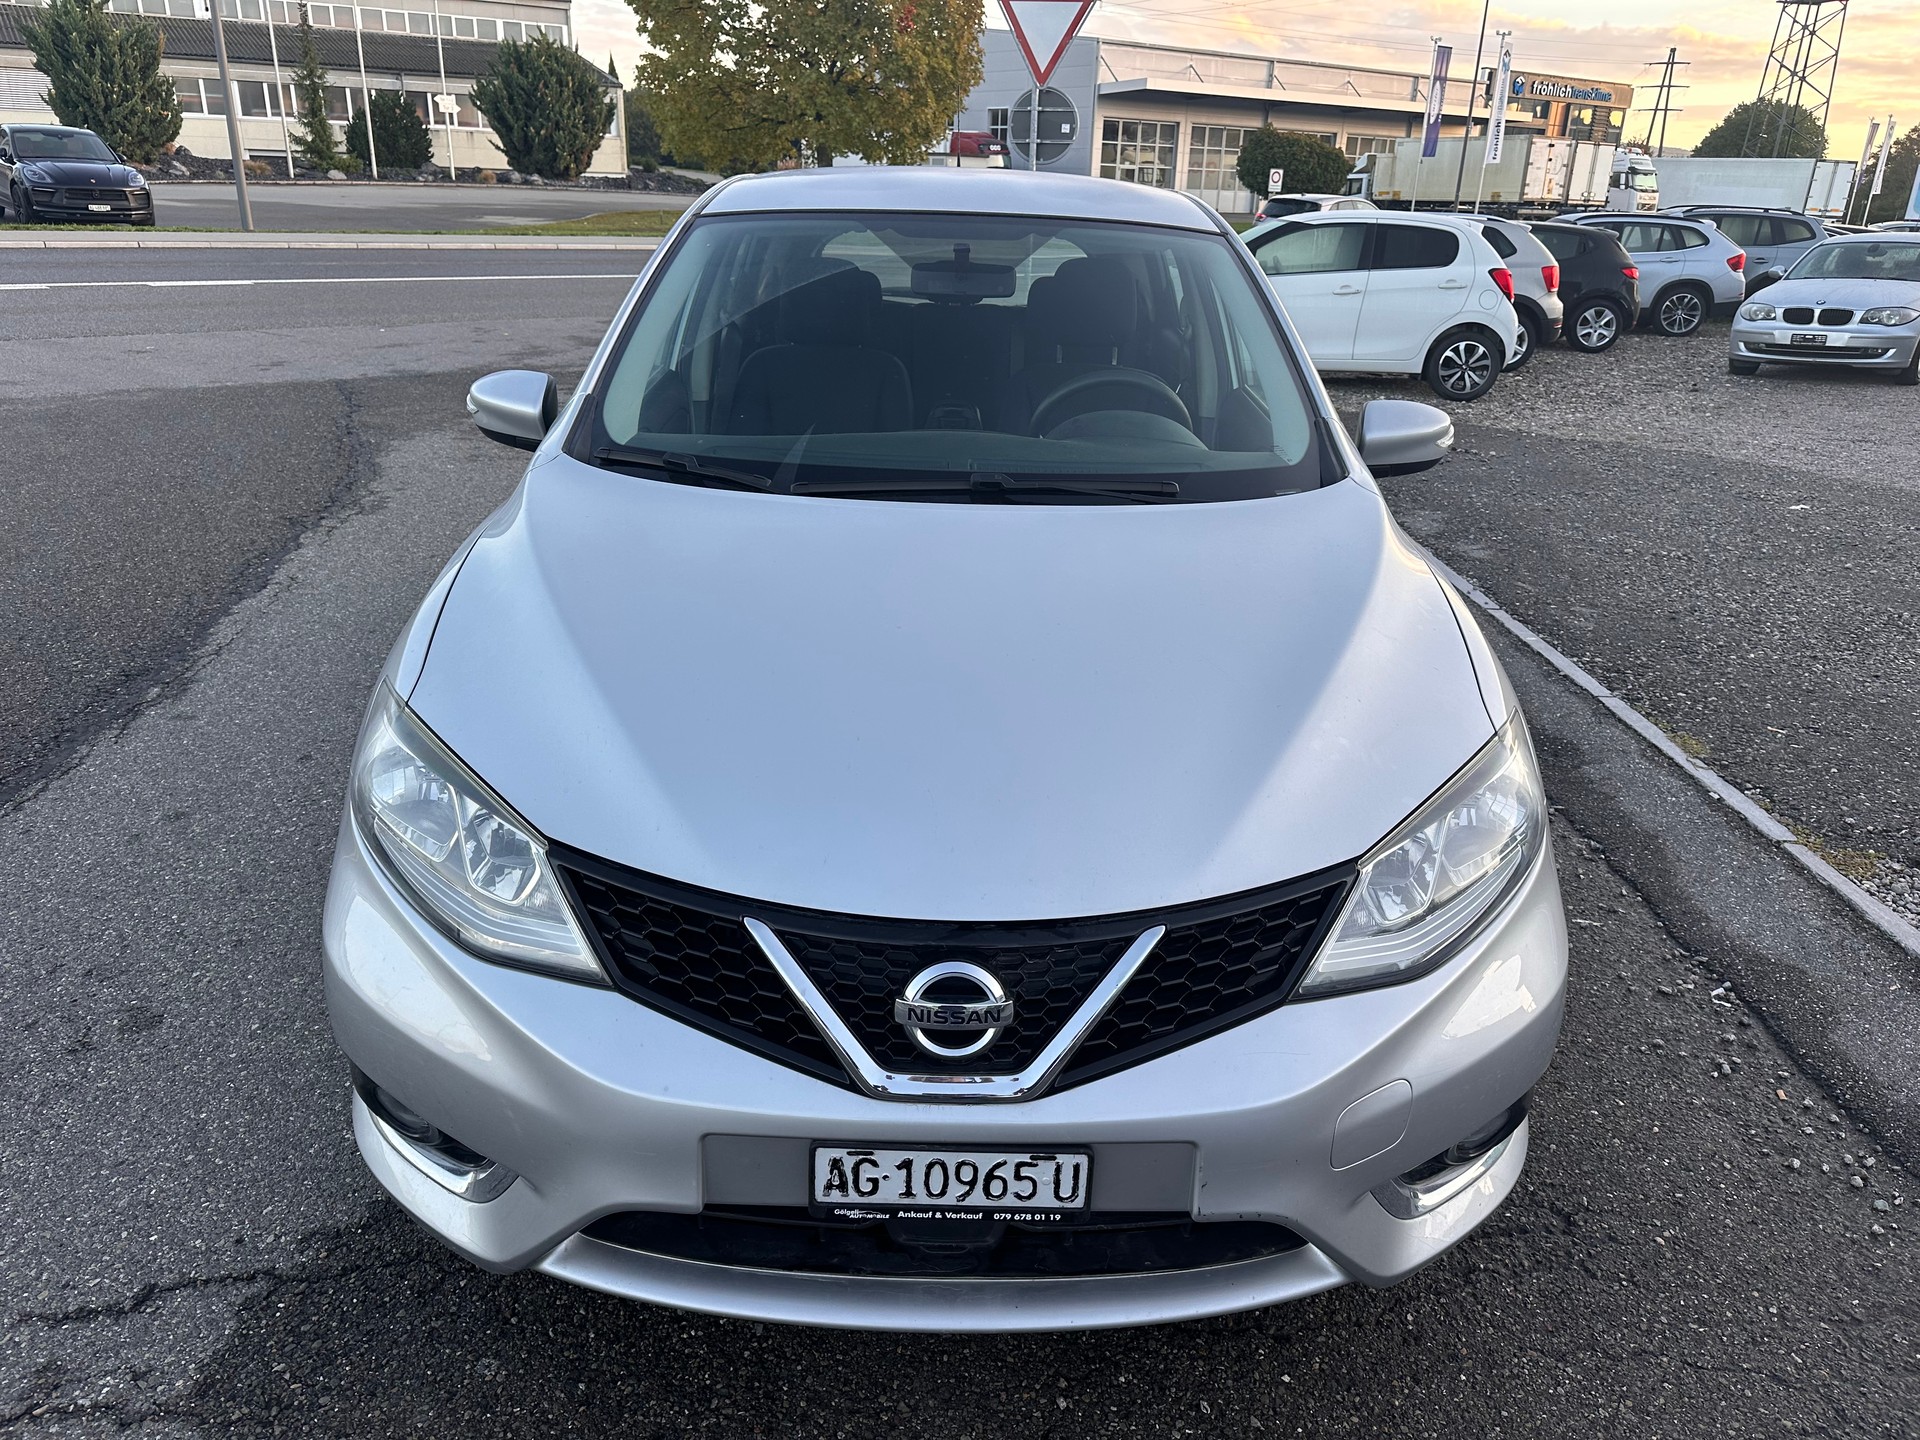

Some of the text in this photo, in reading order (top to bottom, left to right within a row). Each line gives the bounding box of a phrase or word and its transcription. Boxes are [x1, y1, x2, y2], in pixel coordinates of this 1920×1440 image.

[907, 1007, 1001, 1025] NISSAN
[897, 1210, 933, 1219] Ankauf
[934, 1211, 943, 1219] &
[945, 1211, 983, 1220] Verkauf
[1014, 1213, 1032, 1221] 678
[1034, 1213, 1046, 1221] 01
